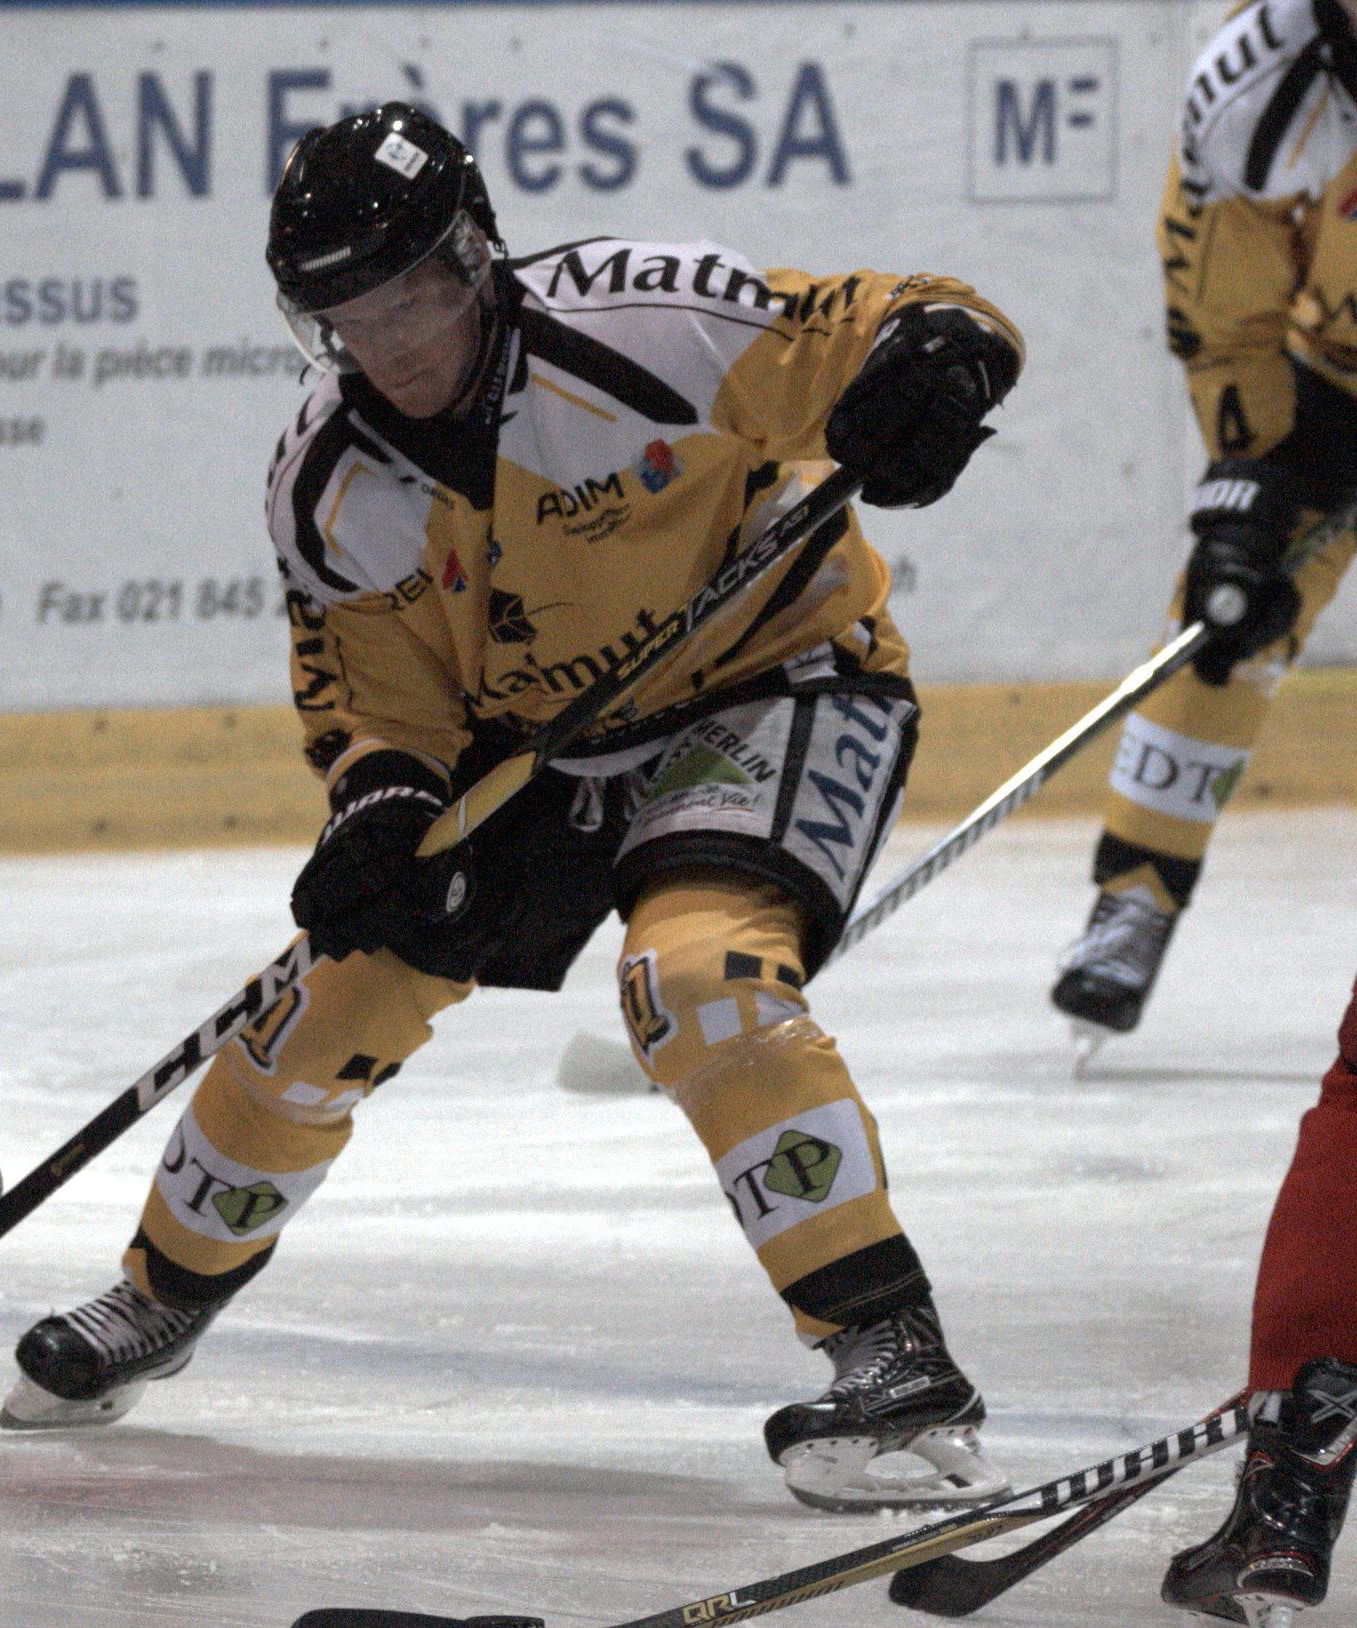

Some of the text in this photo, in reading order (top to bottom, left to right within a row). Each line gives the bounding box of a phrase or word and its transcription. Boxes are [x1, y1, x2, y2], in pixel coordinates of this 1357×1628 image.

[686, 60, 850, 192] SA
[55, 341, 85, 379] la
[202, 337, 306, 380] micro
[536, 472, 625, 525] ADIM
[39, 584, 109, 626] Fax
[116, 580, 182, 624] 021
[194, 578, 266, 621] 845
[794, 696, 916, 882] Mat
[137, 936, 316, 1113] CCM
